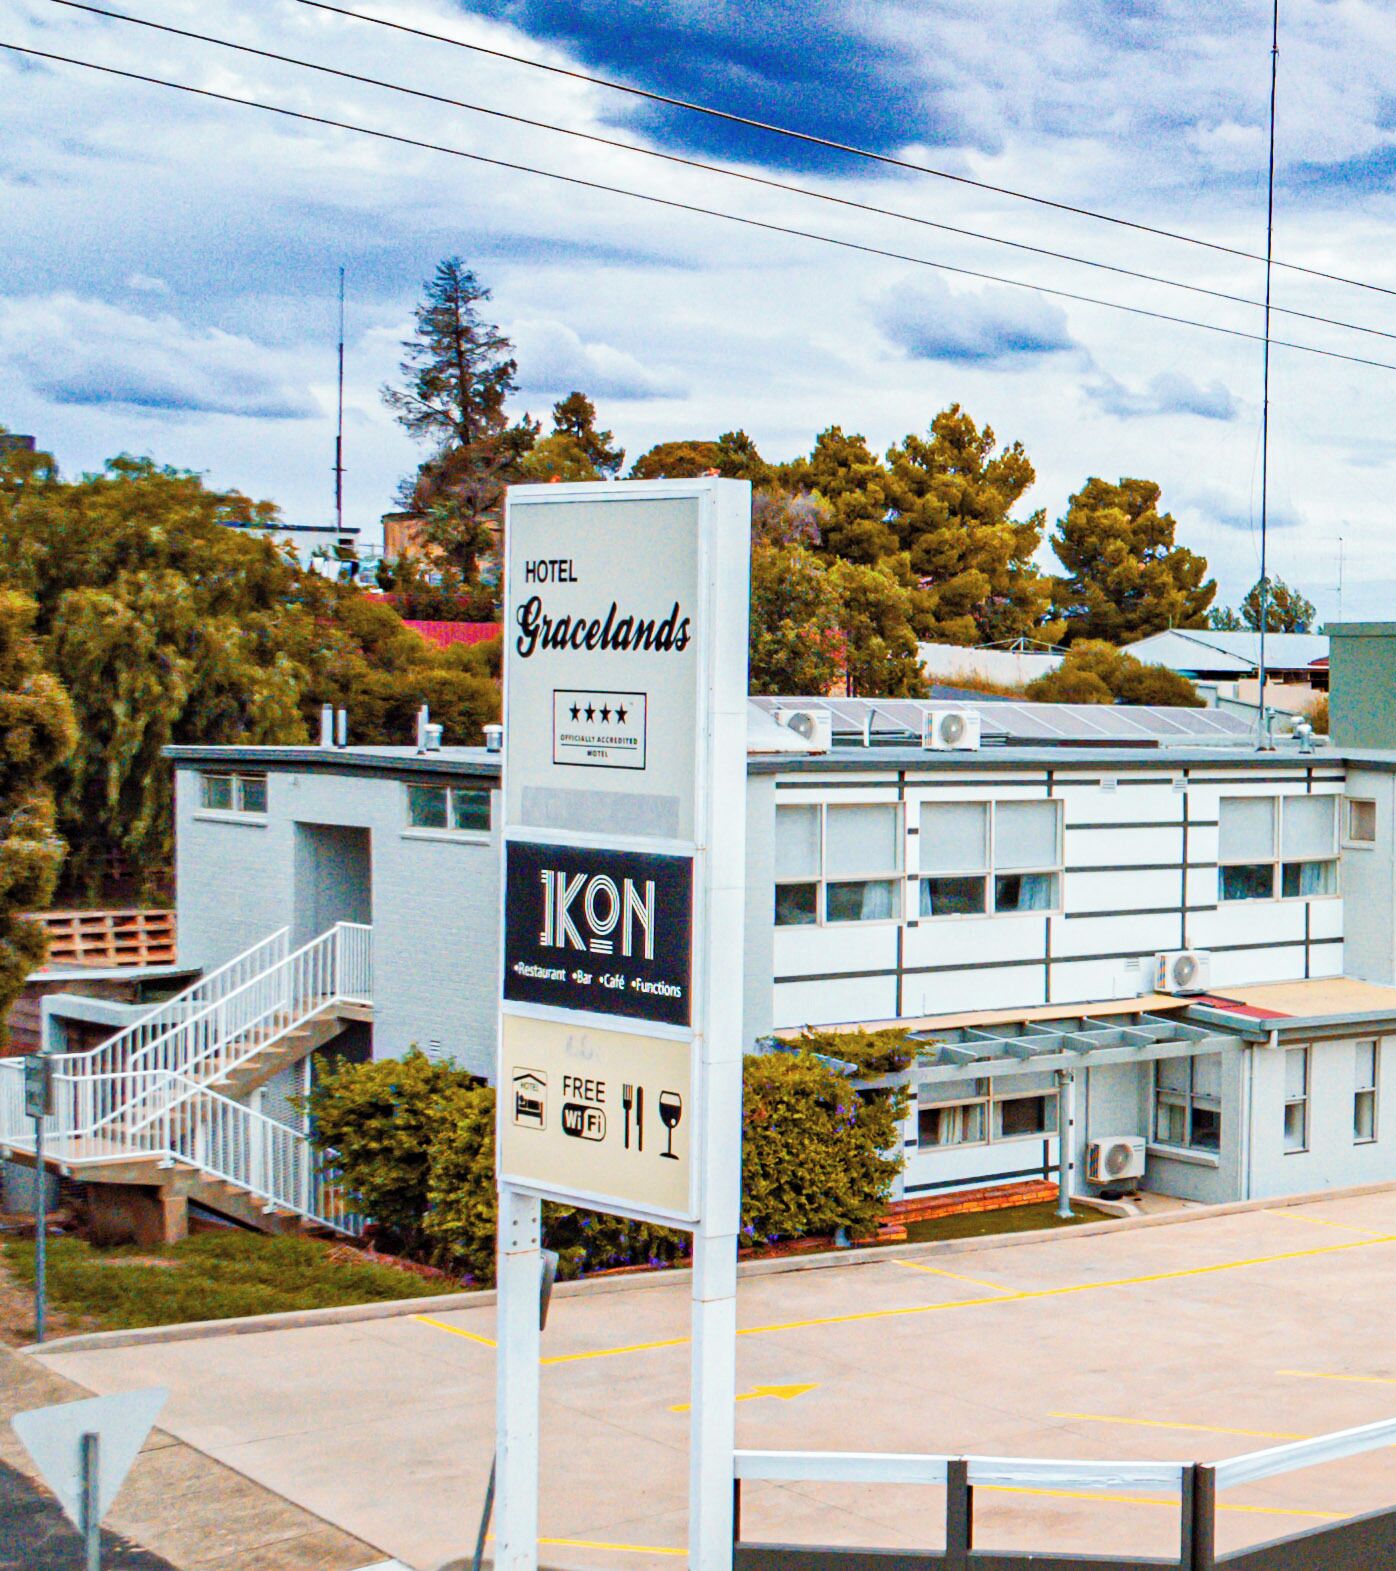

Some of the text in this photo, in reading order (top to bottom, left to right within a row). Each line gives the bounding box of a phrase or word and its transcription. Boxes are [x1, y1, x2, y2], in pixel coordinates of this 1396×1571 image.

[525, 559, 578, 583] HOTEL
[516, 595, 691, 658] Gracelands
[560, 734, 638, 745] OFFICIALLY ACCREDITED
[540, 869, 655, 960] IKON
[518, 961, 682, 998] Restaurant Bar Café Functions
[563, 1075, 606, 1103] FREE
